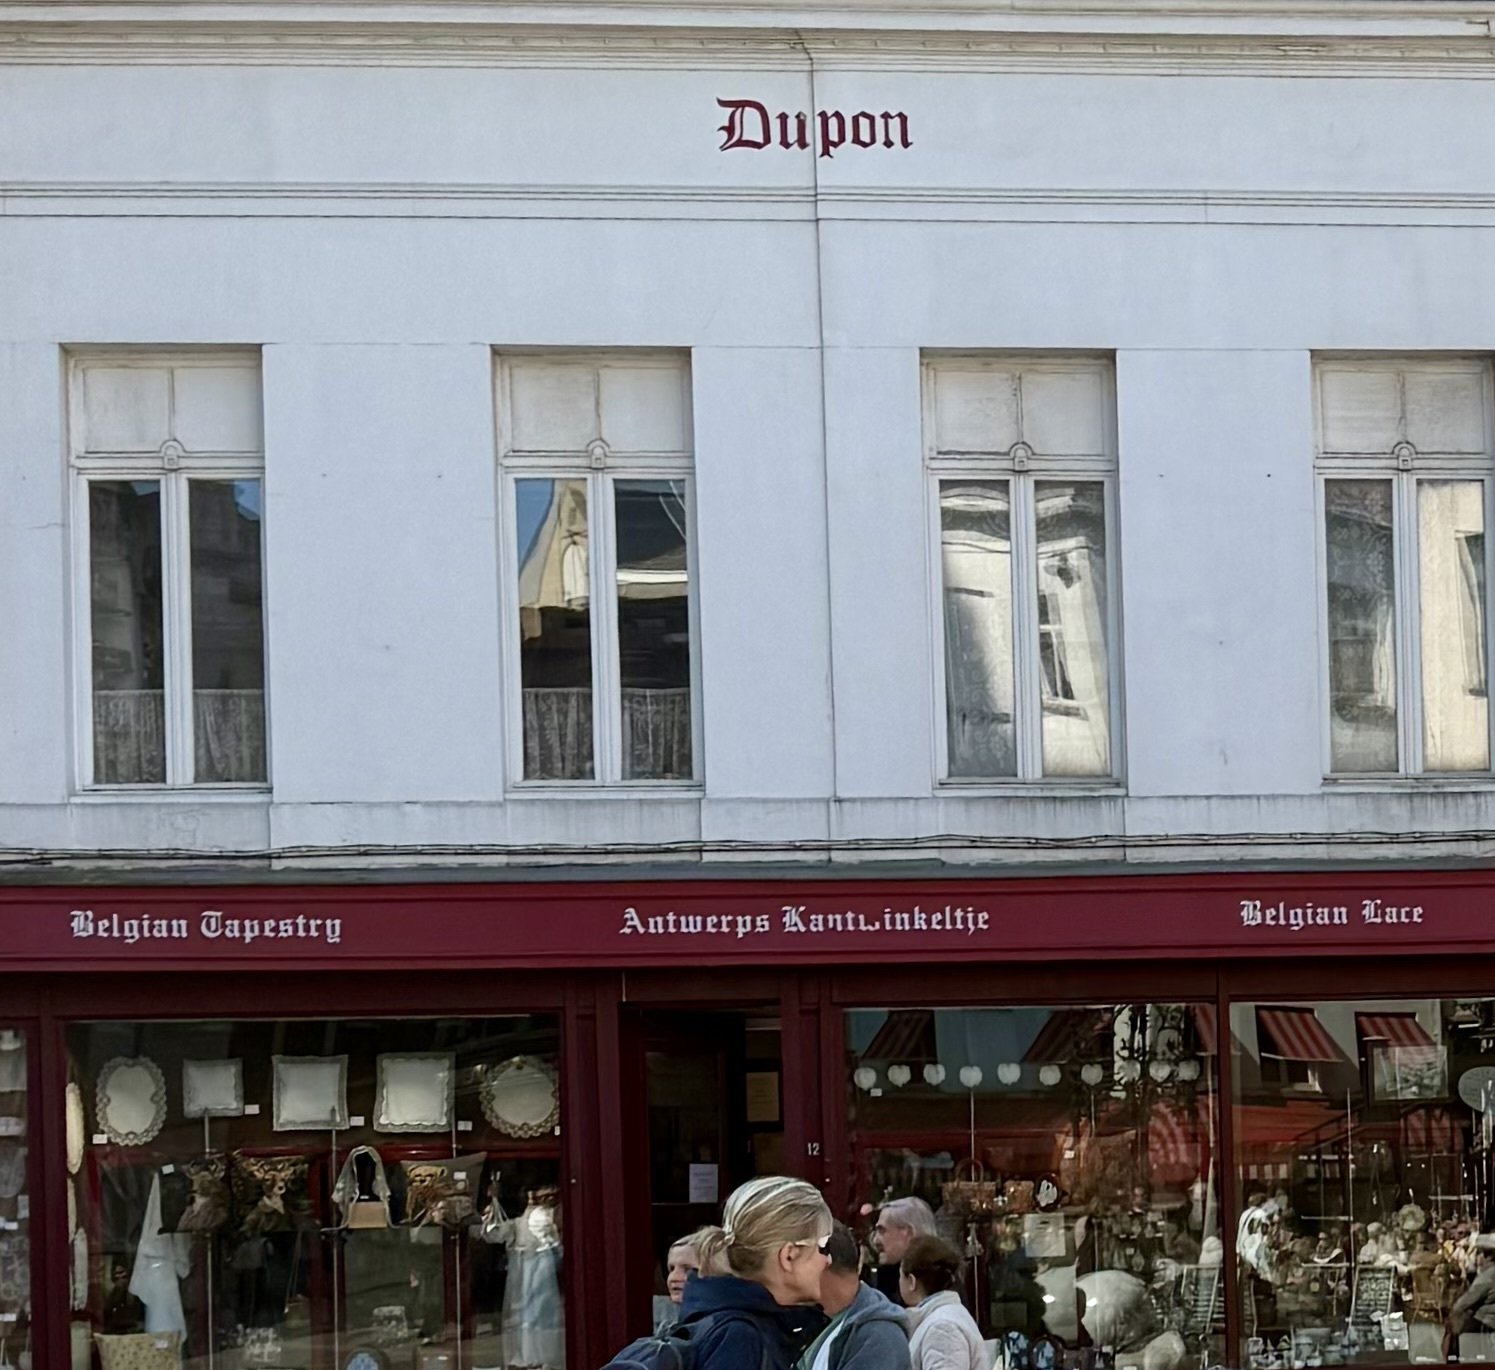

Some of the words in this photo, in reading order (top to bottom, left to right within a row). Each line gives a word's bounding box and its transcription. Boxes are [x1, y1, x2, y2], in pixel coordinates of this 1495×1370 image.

[716, 97, 914, 159] Dupon
[70, 910, 188, 943] Belgian
[200, 910, 342, 943] Tapestry
[619, 907, 771, 939] Antwerps
[1240, 900, 1349, 931] Belgian
[1362, 899, 1424, 925] Lace
[807, 1142, 821, 1156] 12
